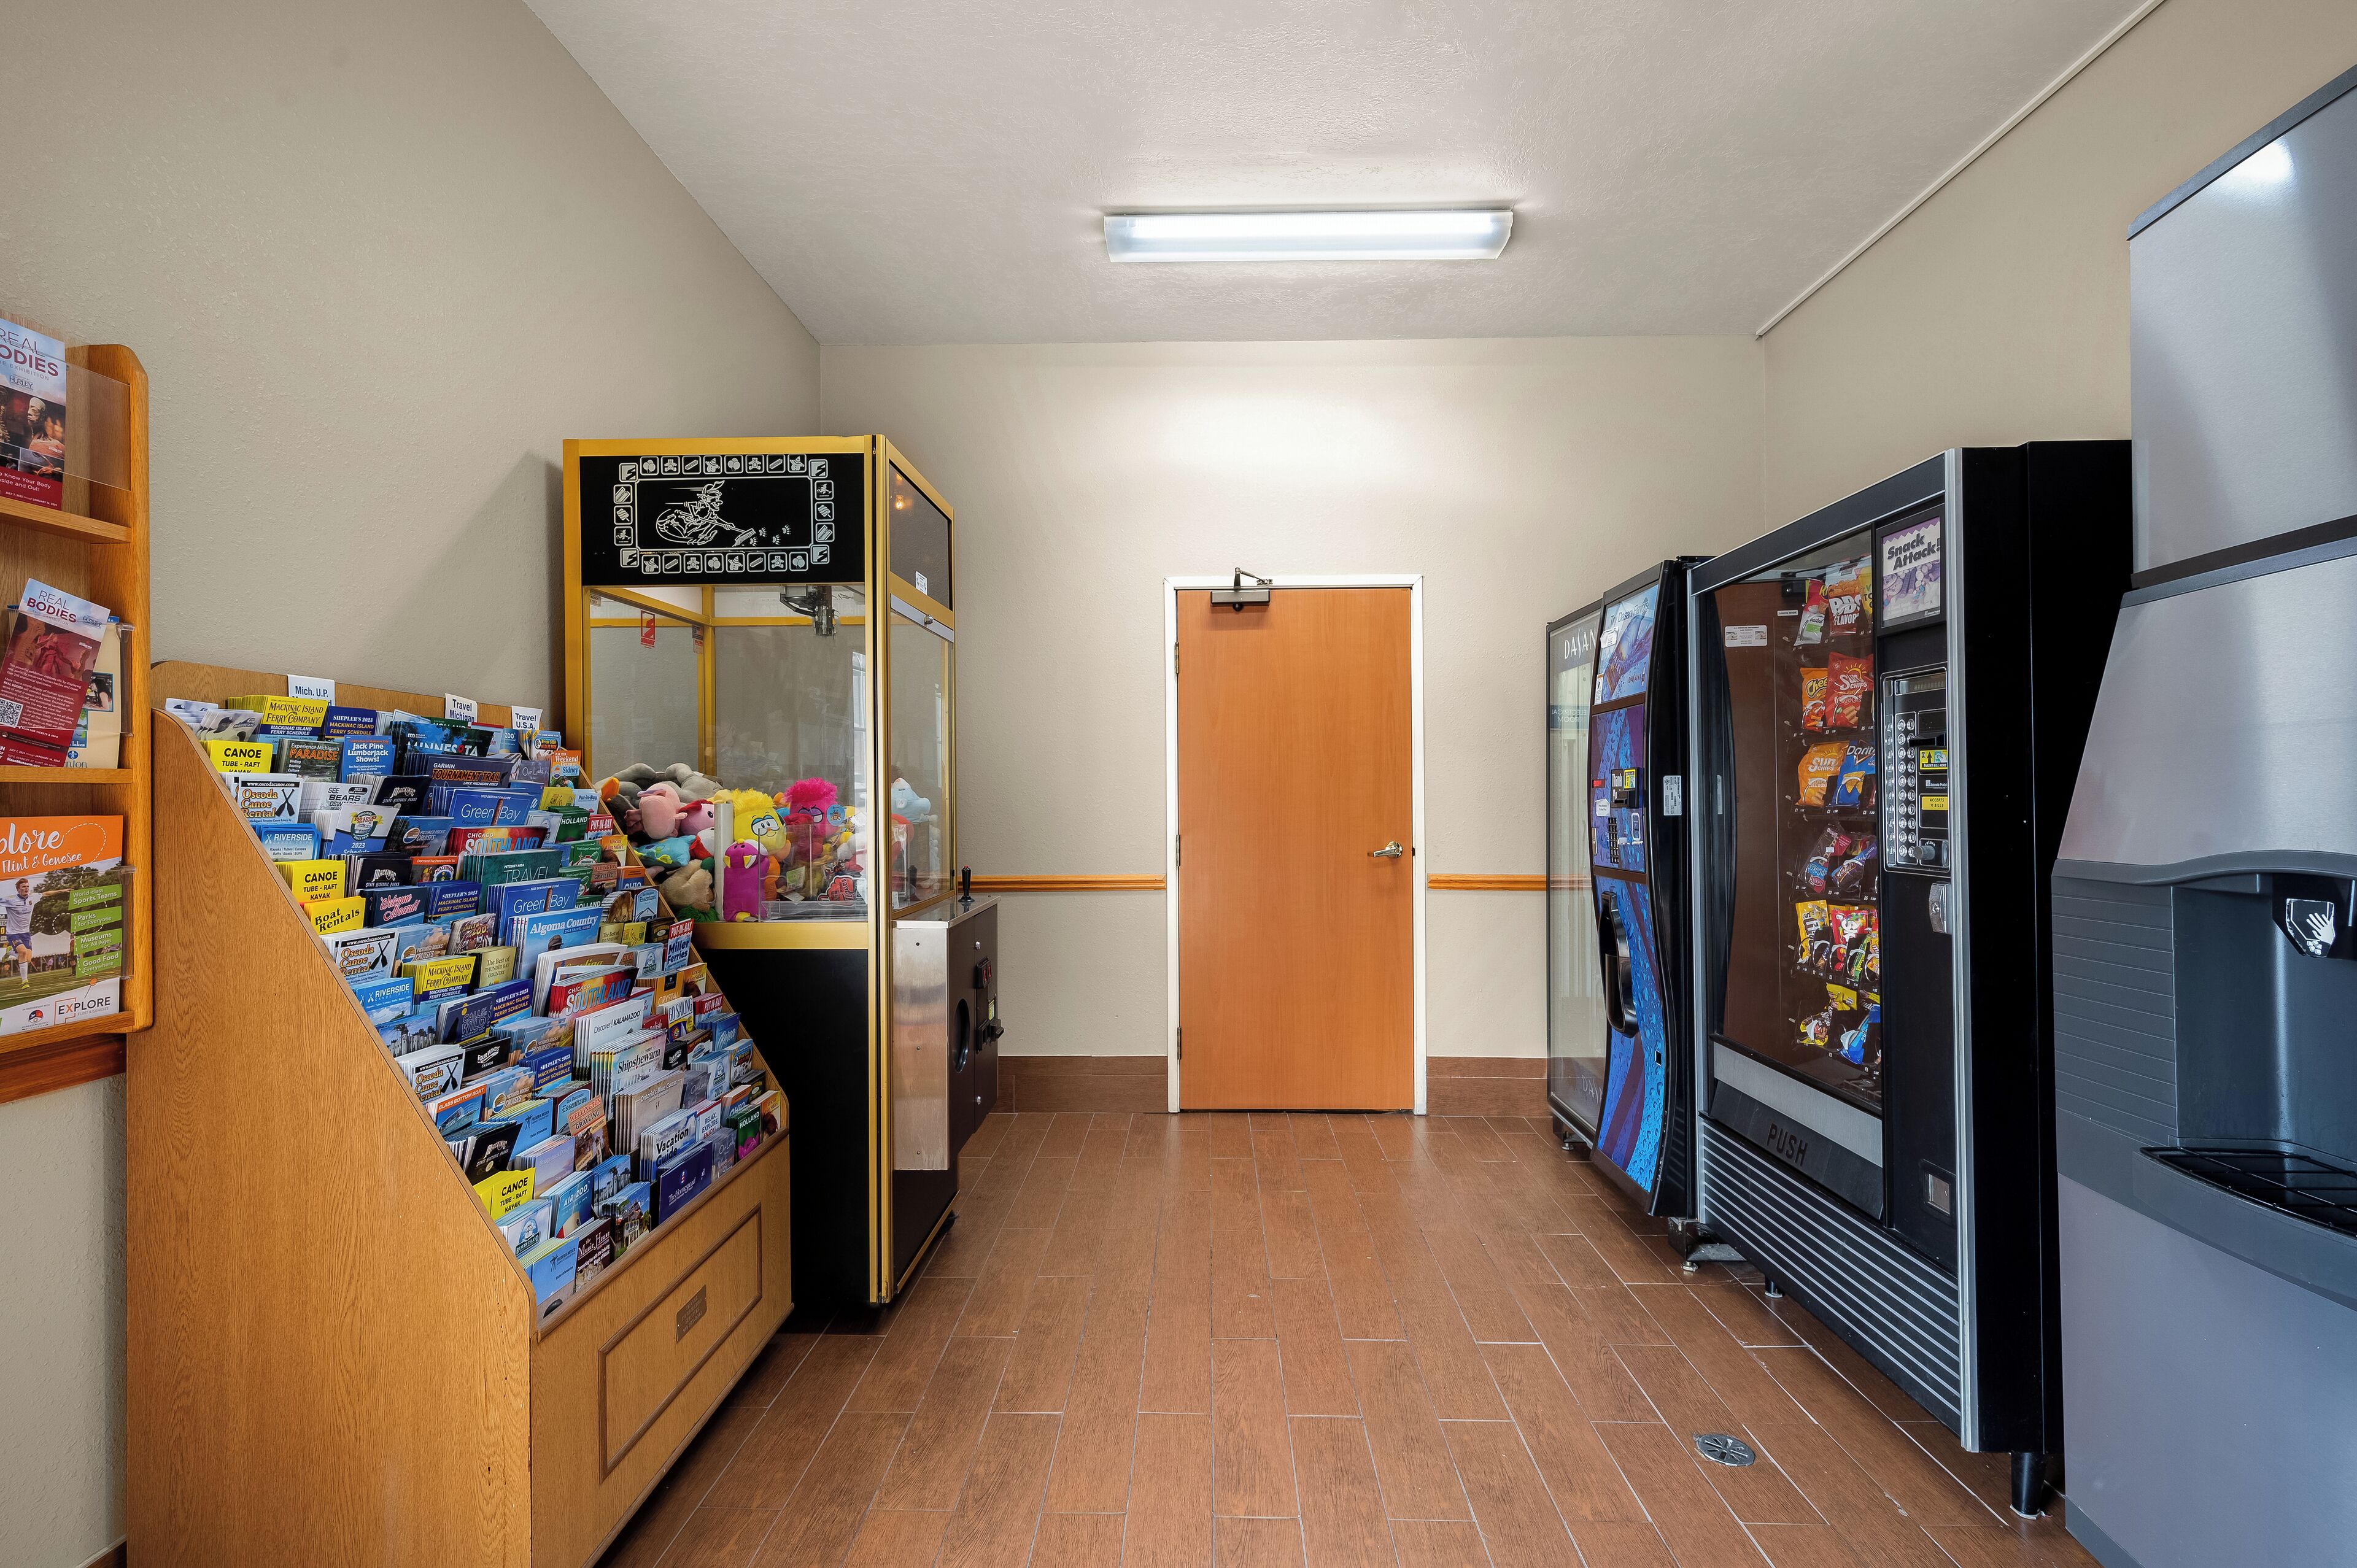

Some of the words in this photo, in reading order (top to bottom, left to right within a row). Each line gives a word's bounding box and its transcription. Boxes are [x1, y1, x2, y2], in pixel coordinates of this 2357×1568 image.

[37, 481, 51, 489] Body
[1887, 533, 1925, 560] Snack
[1893, 538, 1940, 571] Attack!
[38, 590, 69, 611] REAL
[27, 597, 77, 624] BODIES
[1618, 608, 1635, 623] Dasani
[295, 686, 314, 696] Mich.
[316, 688, 329, 698] U.P.
[269, 701, 301, 713] MACKINAC
[302, 705, 323, 714] ISLAND
[452, 698, 472, 712] Travel
[266, 713, 287, 724] FERRY
[287, 712, 320, 724] COMPANY
[449, 711, 474, 722] Michigan
[515, 713, 536, 722] Travel
[223, 747, 261, 759] CANOE
[289, 748, 338, 761] PARADISE
[347, 749, 389, 757] Lumberjack
[432, 768, 479, 780] TOURNAMENT
[481, 771, 500, 782] TRAIL
[562, 766, 579, 775] Sidney
[242, 789, 277, 798] Oscoda
[241, 799, 271, 809] Canoe
[241, 808, 276, 818] Rental
[461, 804, 493, 818] Green
[501, 806, 521, 821] Bay
[561, 816, 588, 825] HOLLAND
[590, 817, 613, 830] PUT-IN-BAY
[2, 856, 29, 873] Flint
[32, 855, 39, 868] &
[304, 871, 338, 883] CANOE
[73, 895, 96, 905] Sports
[379, 894, 412, 910] Welcome
[514, 899, 545, 914] Green
[550, 894, 570, 910] Bay
[315, 908, 341, 926] Boat
[383, 899, 419, 922] Aboard!
[87, 917, 112, 925] Everyone
[319, 908, 360, 933] Rentals
[530, 920, 565, 935] Algoma
[567, 915, 598, 929] Country
[671, 921, 692, 937] PUT-IN-BAY
[80, 932, 112, 943] Museums
[346, 935, 390, 946] www.oscodacanoe.com
[341, 946, 374, 958] Oscoda
[668, 940, 690, 954] Miller
[83, 958, 101, 967] Good
[103, 952, 118, 961] Food
[339, 957, 367, 968] Canoe
[415, 951, 434, 961] CRUISES
[667, 951, 688, 965] Ferries
[83, 962, 114, 972] Everywhere
[339, 963, 371, 976] Rental
[428, 967, 453, 977] MACKINAC
[453, 963, 471, 973] ISLAND
[426, 978, 441, 989] FERRY
[441, 973, 470, 986] COMPANY
[375, 983, 410, 998] RIVERSIDE
[568, 984, 590, 994] CHICAGO
[493, 1000, 514, 1011] MACKINAC
[515, 995, 530, 1005] ISLAND
[566, 978, 631, 1016] SOUTHLAND
[58, 997, 110, 1015] EXPLORE
[494, 1008, 508, 1018] FERRY
[508, 1001, 528, 1013] SCHEDULE
[676, 998, 692, 1019] SAILING
[462, 1017, 486, 1035] WILD
[614, 1010, 641, 1027] KALAMAZOO
[617, 1048, 660, 1074] Shipshewana
[416, 1070, 443, 1083] Oscoda
[538, 1068, 557, 1078] MACKINAC
[558, 1060, 571, 1070] ISLAND
[539, 1075, 551, 1084] FERRY
[551, 1067, 570, 1079] SCHEDULE
[414, 1081, 438, 1093] Canoe
[438, 1101, 452, 1110] GLASS
[452, 1092, 472, 1105] BOTTOM
[472, 1087, 484, 1097] BOAT
[505, 1095, 522, 1108] CRUISES
[562, 1096, 587, 1113] Essenhaus
[569, 1097, 602, 1122] WELLINGTON
[575, 1110, 600, 1130] GRAYLING
[739, 1111, 760, 1129] HOLLAND
[656, 1128, 689, 1154] Vacation
[1767, 1124, 1808, 1167] PUSH
[656, 1147, 678, 1167] Guide
[501, 1177, 528, 1197] CANOE
[500, 1197, 512, 1207] TUBE
[516, 1189, 527, 1199] RAFT
[563, 1197, 574, 1207] AIR
[575, 1184, 588, 1198] ZOO
[505, 1200, 521, 1213] KAYAK
[578, 1243, 594, 1258] Music
[594, 1231, 610, 1250] House
